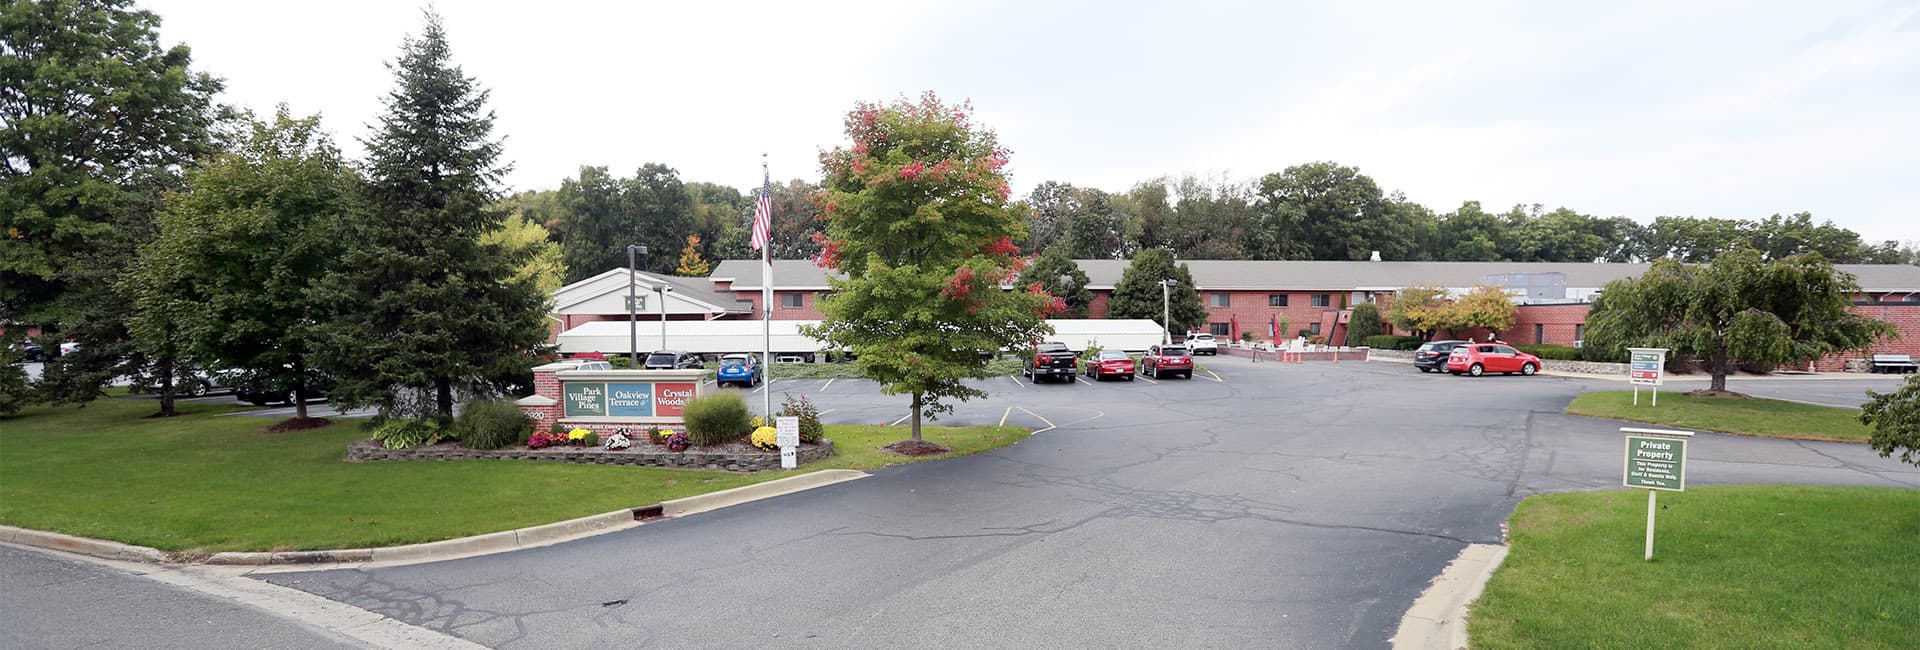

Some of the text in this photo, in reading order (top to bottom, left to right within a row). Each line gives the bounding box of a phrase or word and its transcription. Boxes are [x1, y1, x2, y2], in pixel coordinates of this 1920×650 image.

[583, 387, 602, 395] Park
[615, 390, 650, 400] Oakview
[663, 389, 693, 400] Crystal
[569, 393, 596, 404] Village
[608, 398, 640, 406] Terrace
[657, 397, 684, 406] Woods
[578, 401, 600, 409] Pines
[1640, 440, 1671, 450] Private
[1636, 449, 1673, 460] Property
